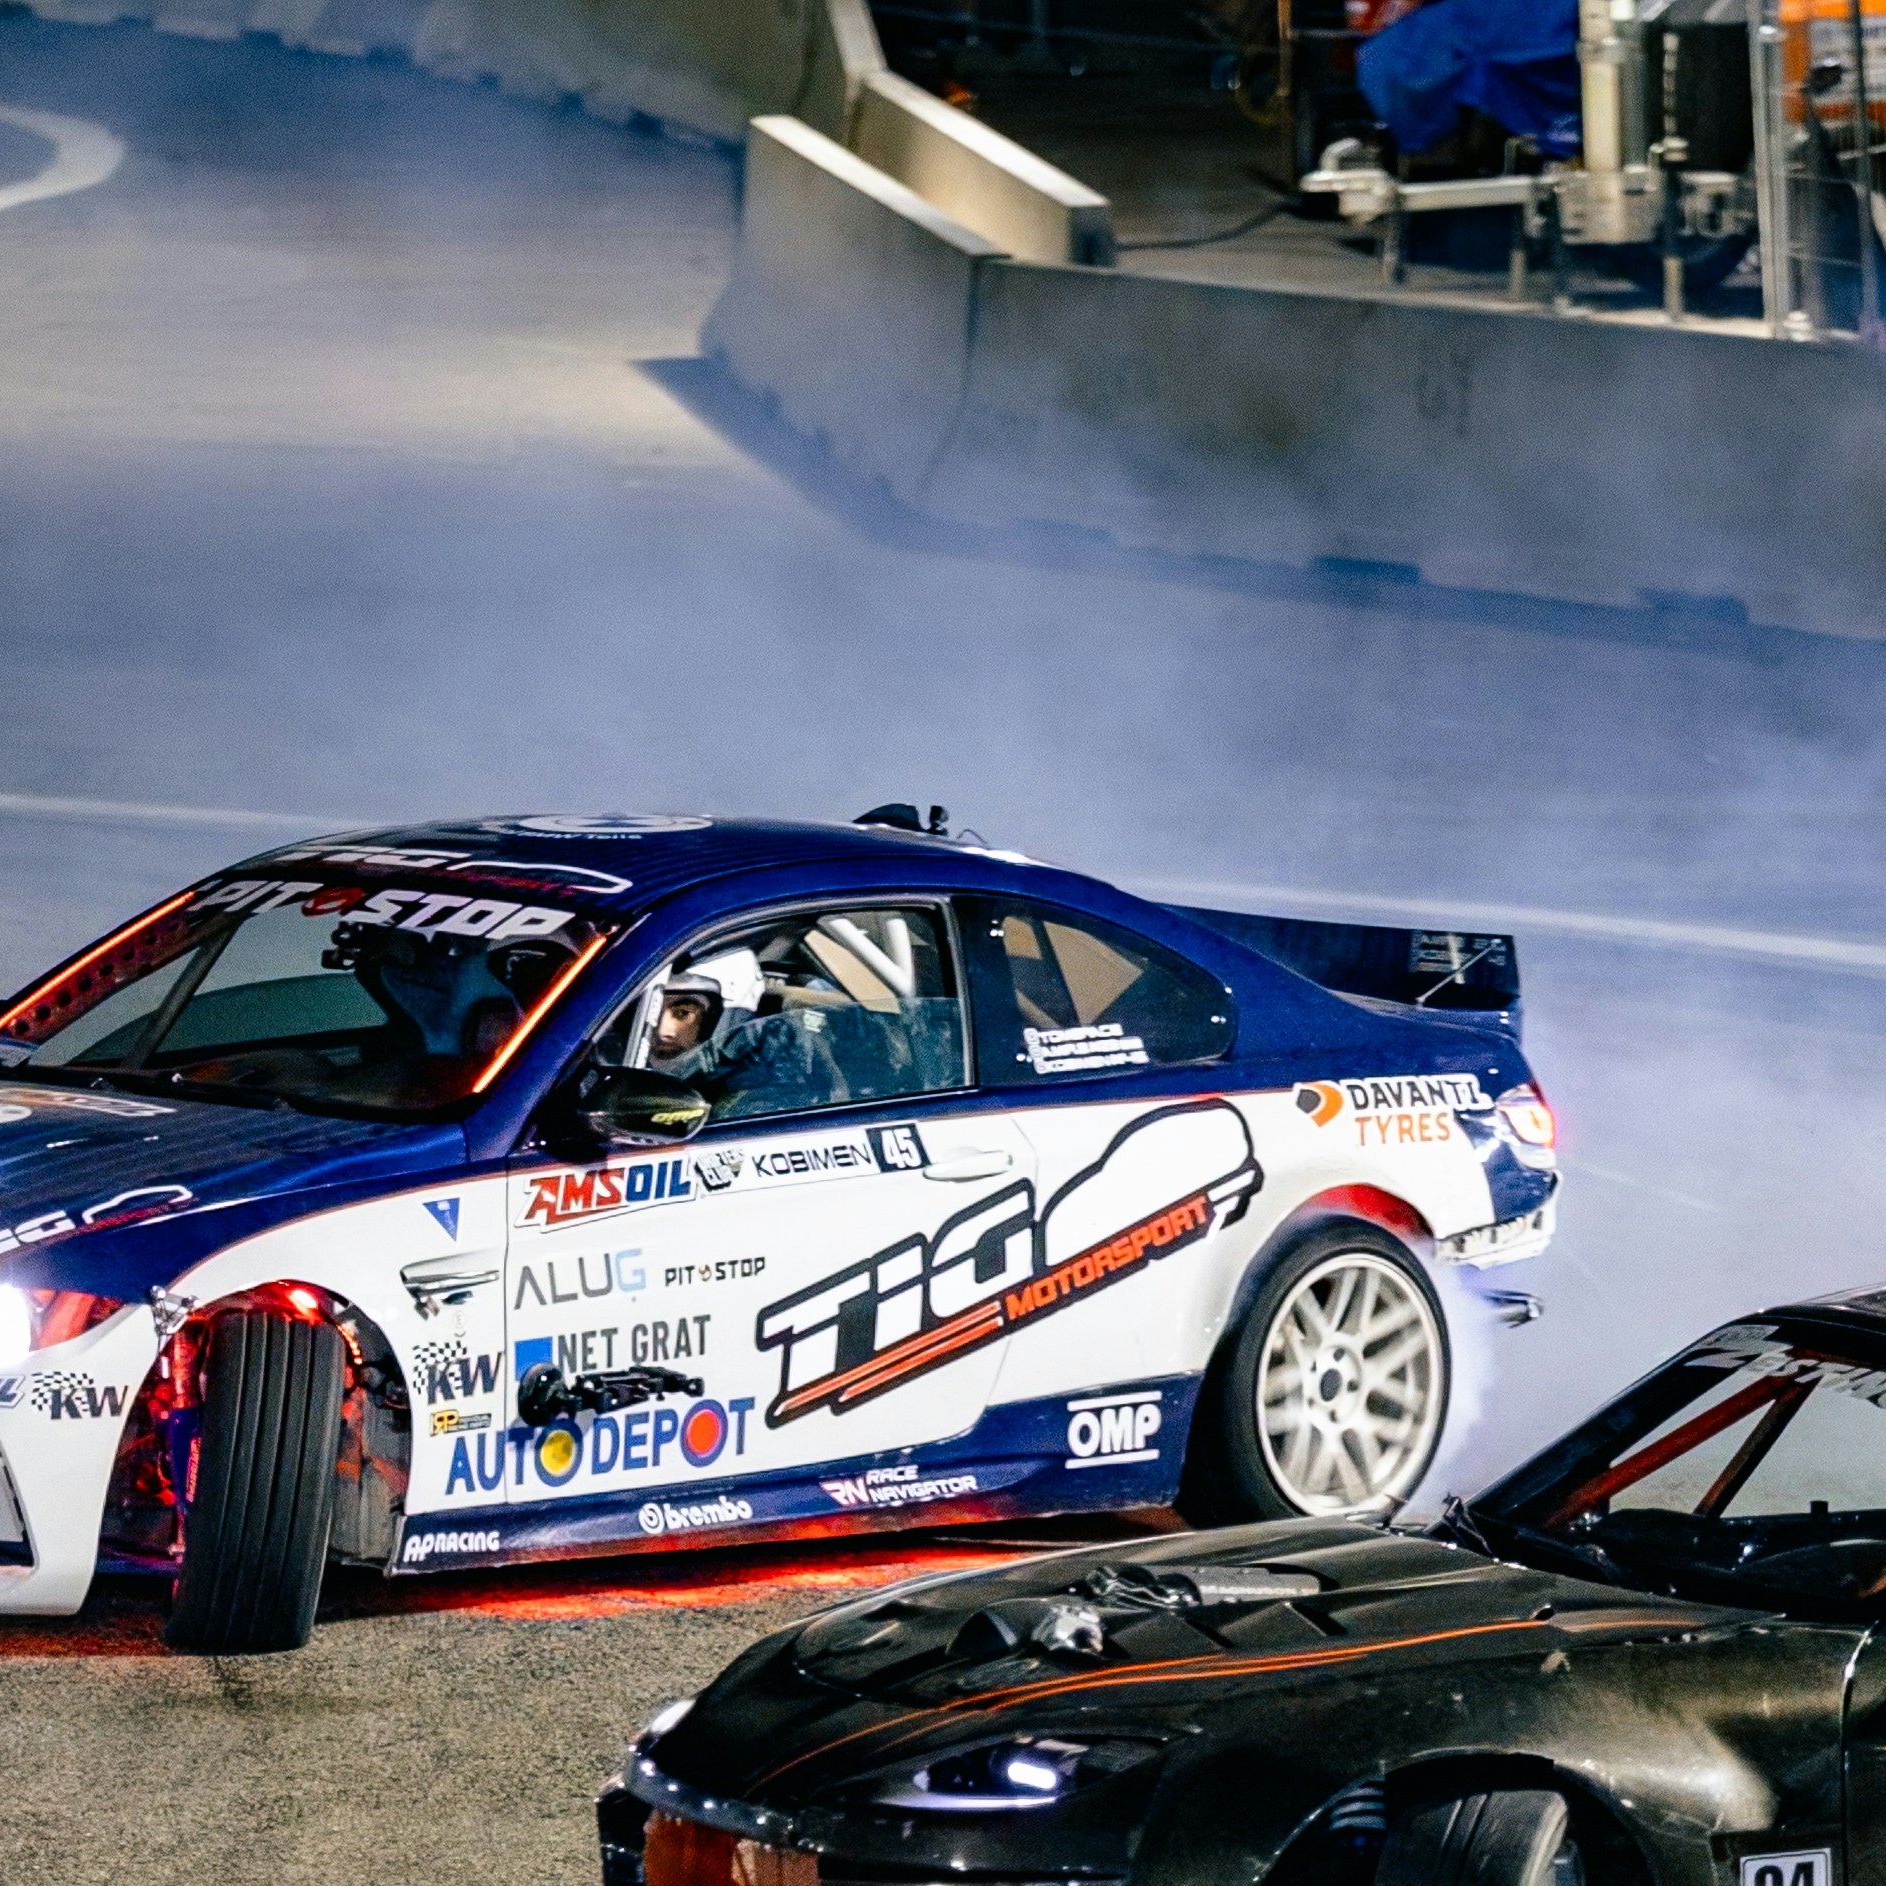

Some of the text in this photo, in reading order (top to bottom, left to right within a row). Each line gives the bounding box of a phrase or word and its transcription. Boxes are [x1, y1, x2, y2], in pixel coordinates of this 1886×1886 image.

[339, 889, 577, 940] STOP
[1347, 1080, 1480, 1110] DAVANTI
[752, 1127, 923, 1178] KOBIMEN 45
[1355, 1112, 1452, 1146] TYRES
[524, 1158, 694, 1226] AMSOIL
[514, 1248, 647, 1311] ALUG
[664, 1257, 766, 1288] PIT STOP
[1005, 1192, 1210, 1321] MOTORSPORT
[759, 1186, 1037, 1396] TIG
[557, 1314, 712, 1374] NET GRAT
[49, 1384, 130, 1421] KW
[427, 1350, 504, 1405] KW
[1066, 1403, 1162, 1458] OMP
[866, 1465, 919, 1485] RACE
[866, 1475, 979, 1504] NAVIGATOR
[662, 1495, 754, 1531] brembo
